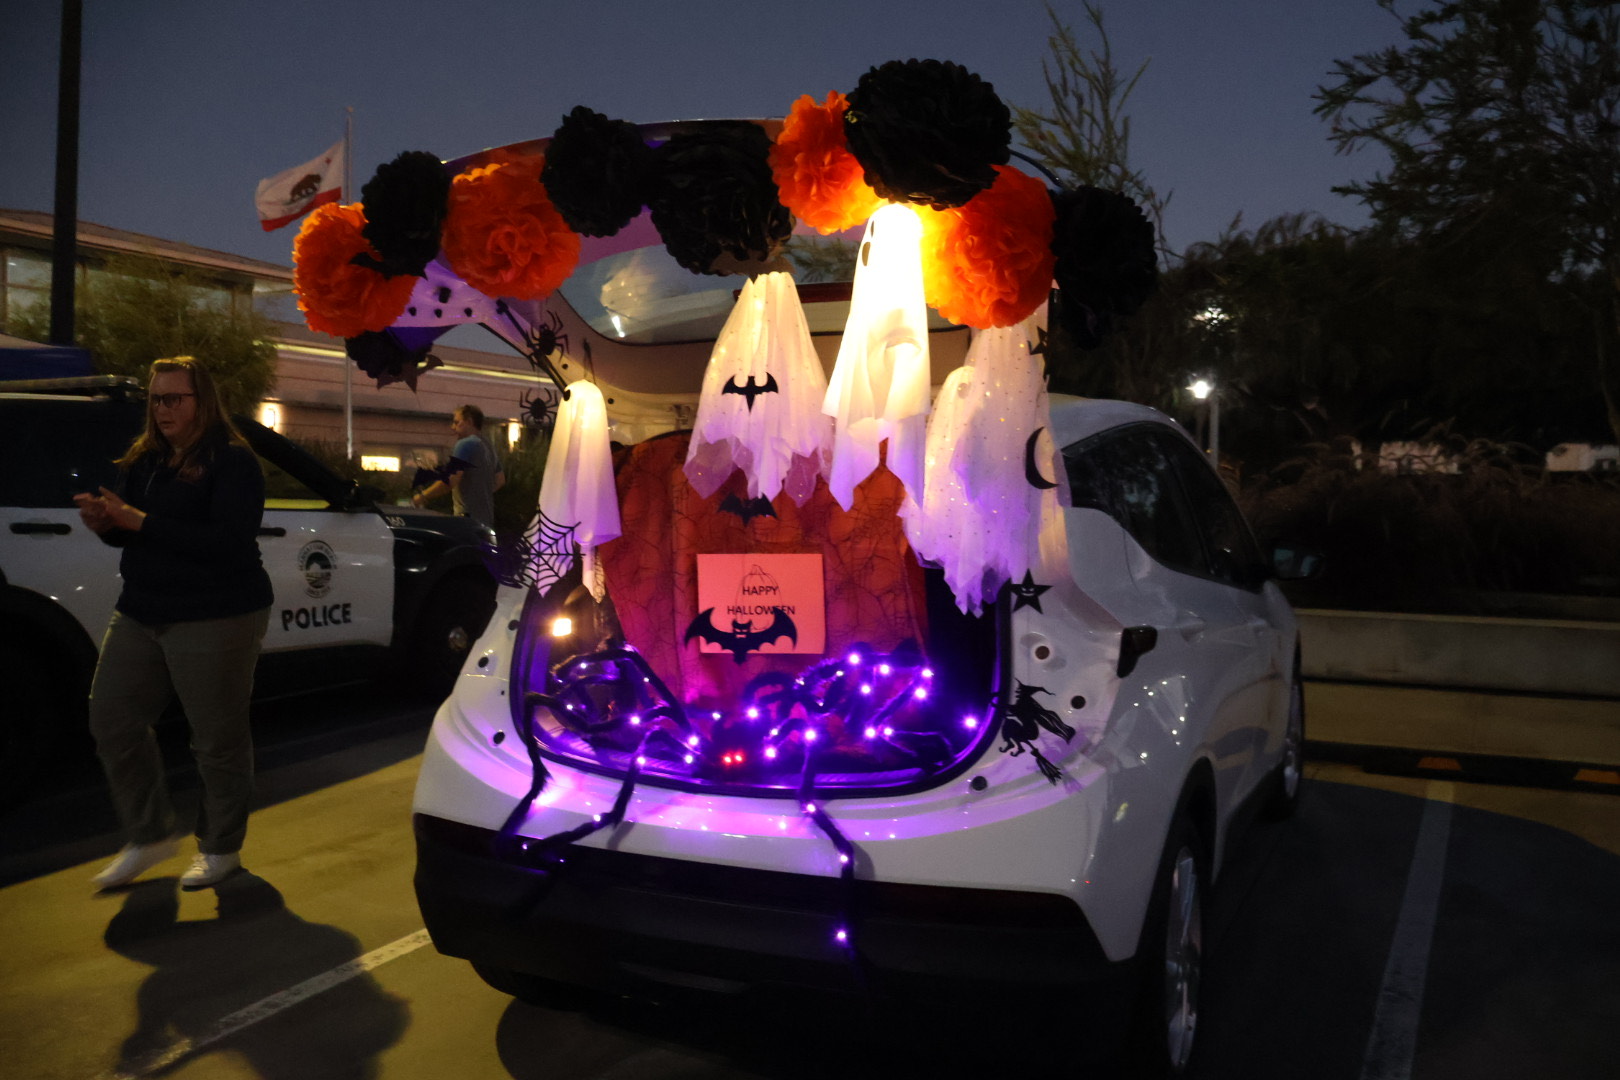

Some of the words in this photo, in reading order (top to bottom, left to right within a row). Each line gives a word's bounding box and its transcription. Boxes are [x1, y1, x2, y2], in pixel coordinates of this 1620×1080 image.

[742, 586, 779, 596] HAPPY
[727, 605, 795, 615] HALLOWEN
[281, 603, 352, 632] POLICE
